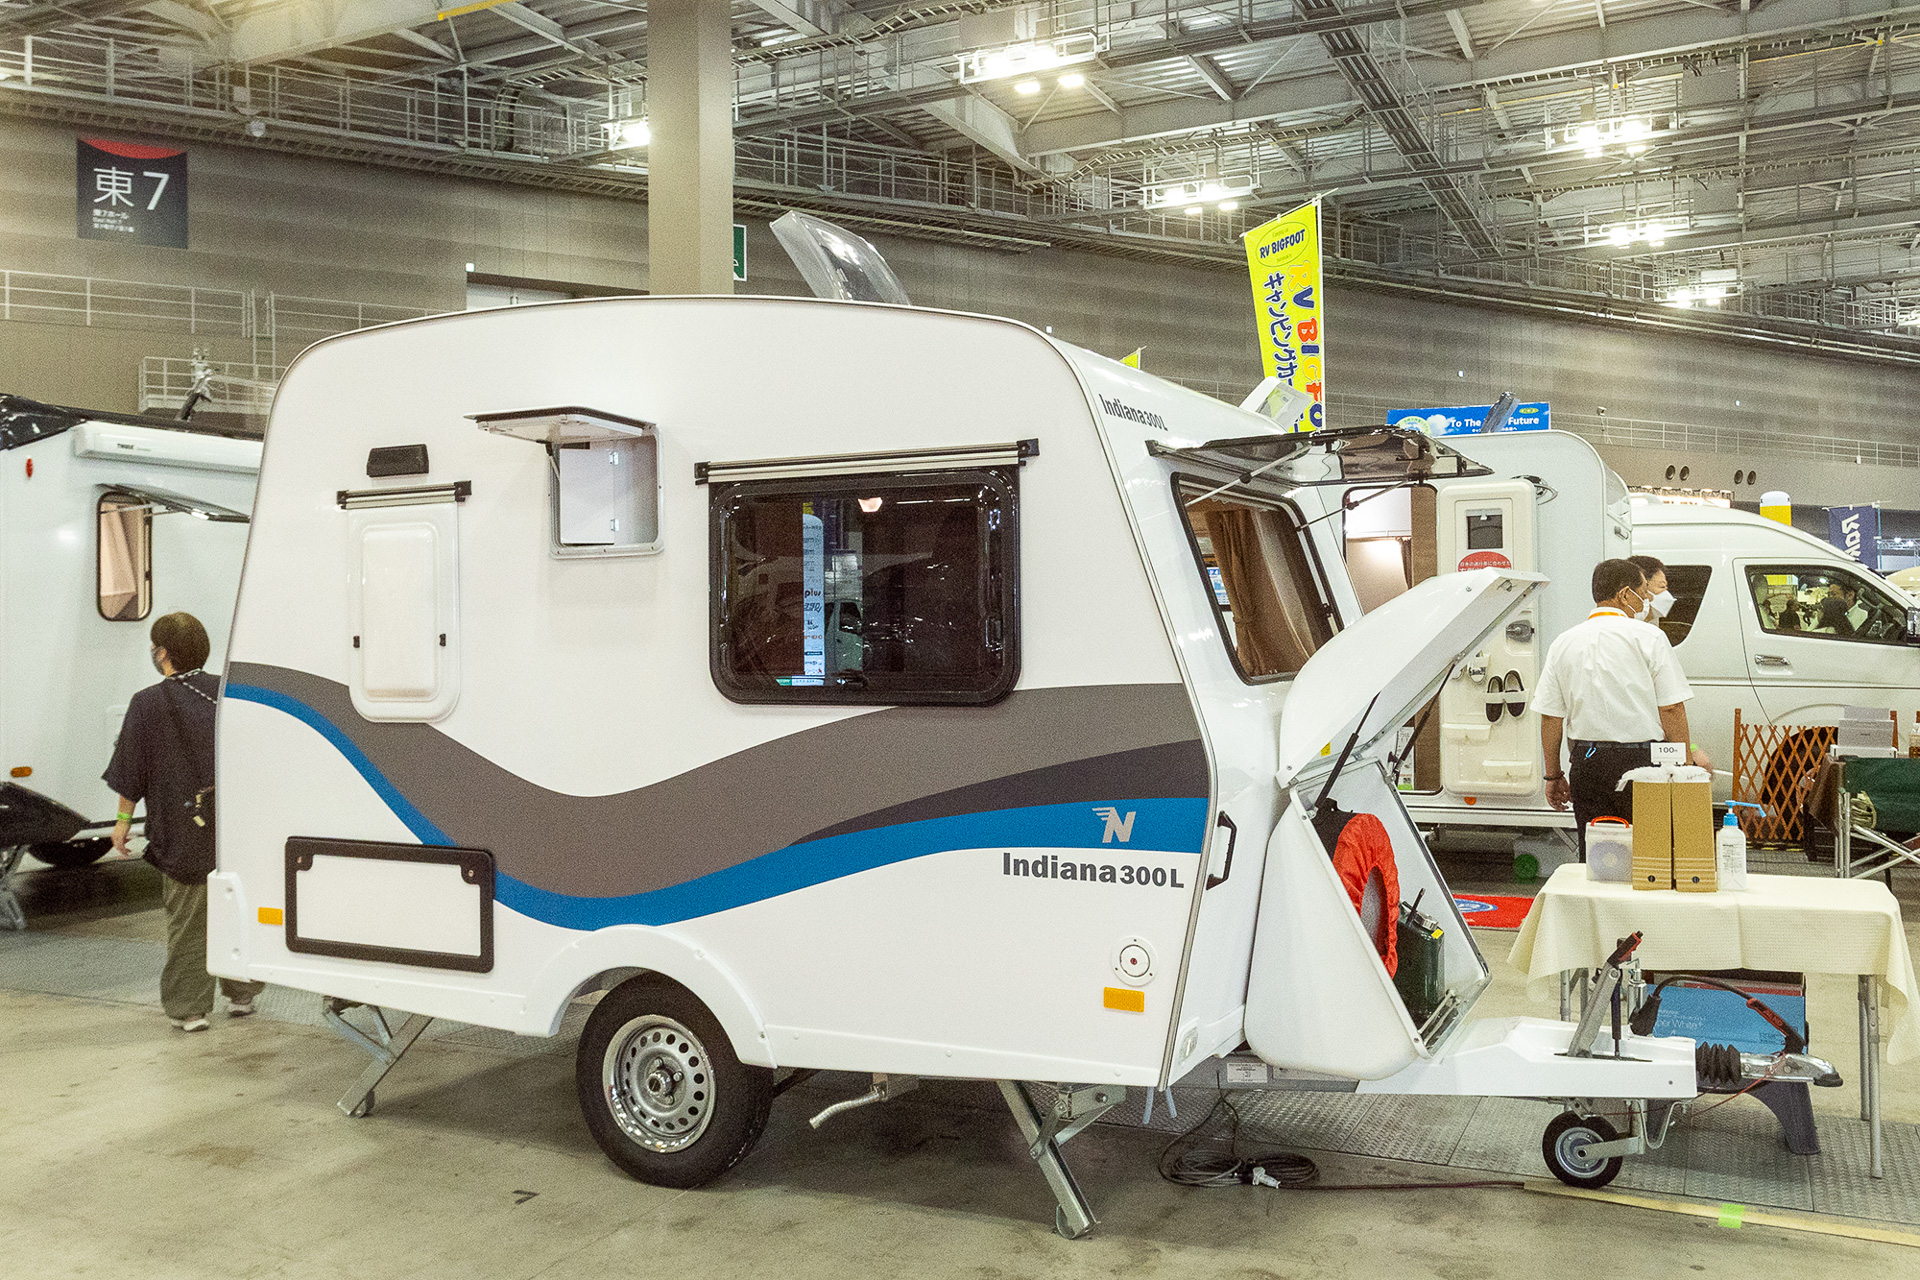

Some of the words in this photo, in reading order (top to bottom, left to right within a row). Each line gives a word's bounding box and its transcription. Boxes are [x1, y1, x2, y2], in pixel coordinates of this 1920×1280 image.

[1259, 244, 1270, 259] RV
[1271, 228, 1305, 254] BIGFOOT
[1288, 260, 1315, 309] RV
[1451, 419, 1462, 428] To
[1465, 418, 1482, 427] The
[1508, 416, 1540, 426] Future
